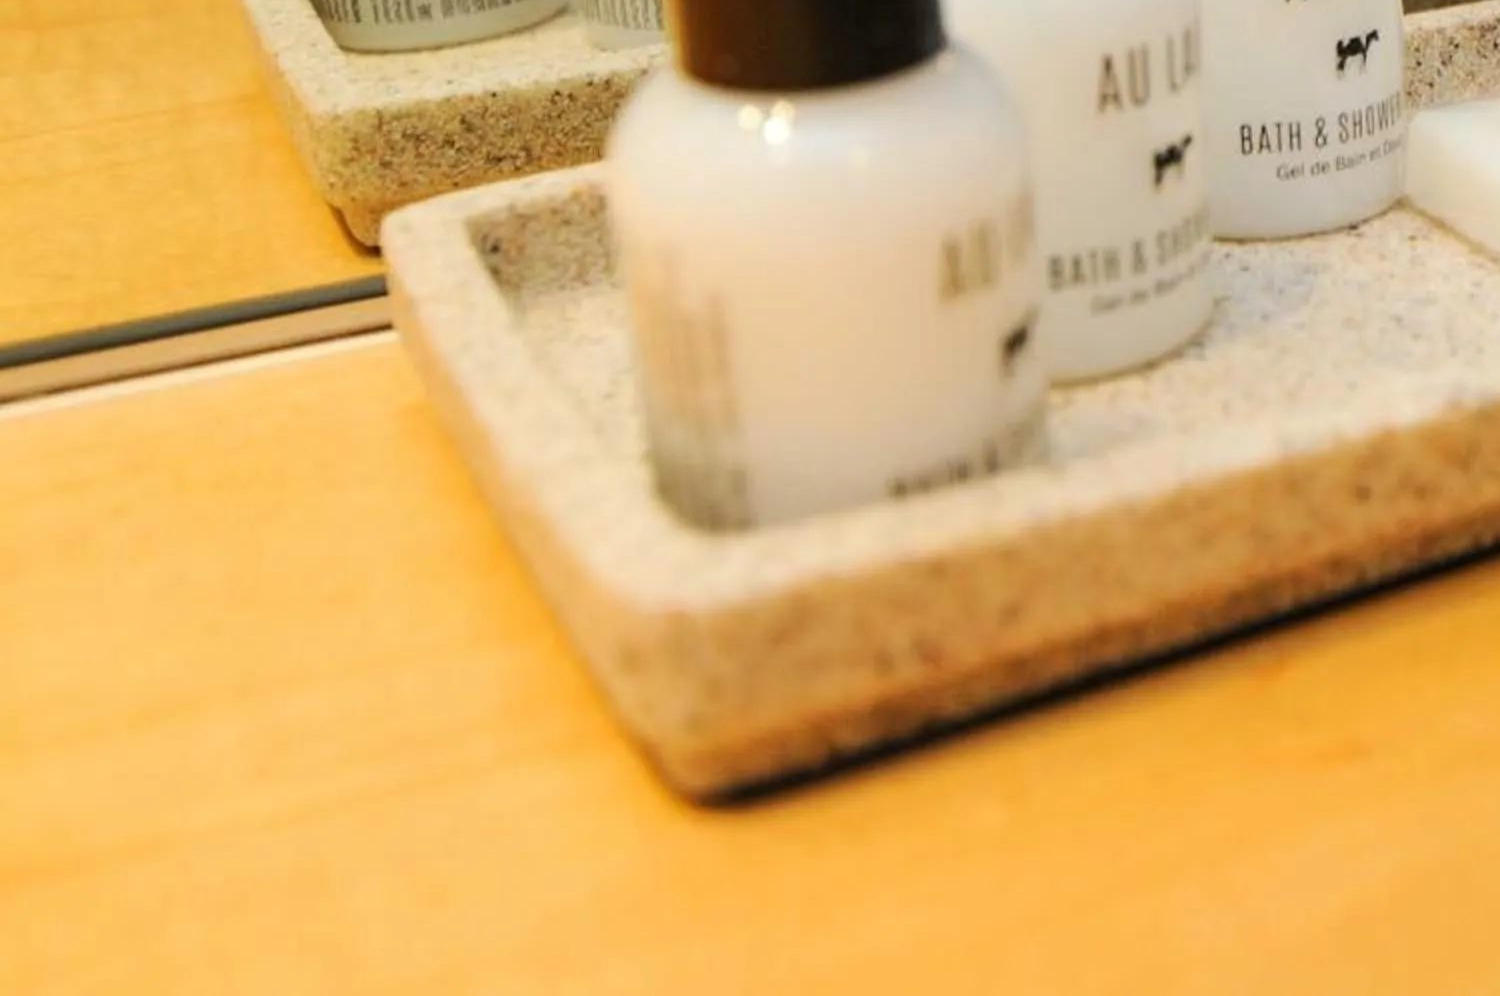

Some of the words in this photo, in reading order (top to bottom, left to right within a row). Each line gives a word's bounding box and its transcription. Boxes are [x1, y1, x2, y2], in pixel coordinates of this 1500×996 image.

[1098, 45, 1149, 114] AU
[1239, 118, 1302, 155] BATH
[1315, 116, 1328, 148] &
[1277, 161, 1305, 181] Gel
